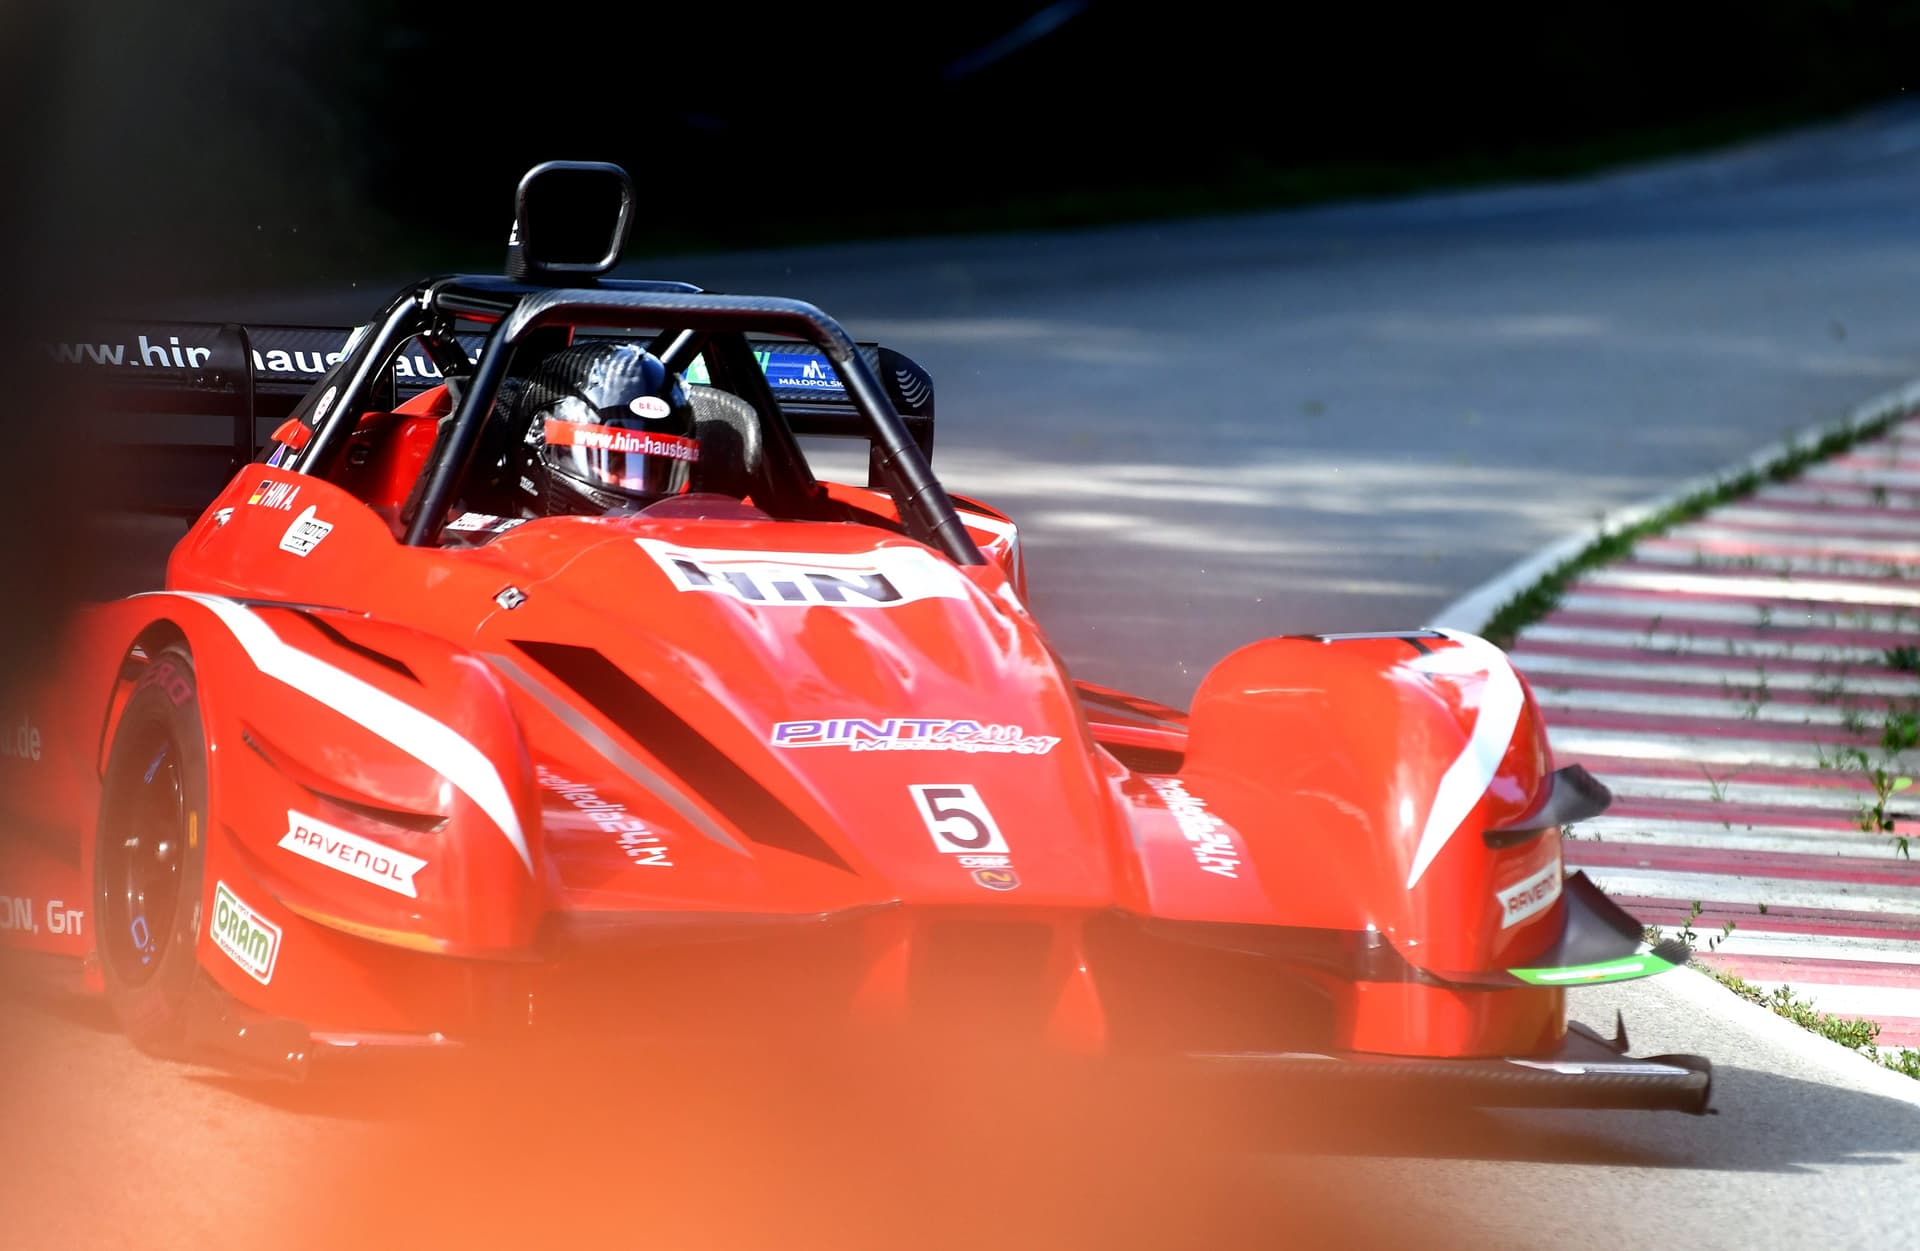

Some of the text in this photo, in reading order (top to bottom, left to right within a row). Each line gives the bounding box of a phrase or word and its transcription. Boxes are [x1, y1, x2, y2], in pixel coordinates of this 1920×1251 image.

[778, 378, 845, 388] MAŁOPOLSK
[638, 400, 665, 413] BELL
[771, 719, 982, 746] PINTA
[921, 788, 992, 850] 5
[293, 826, 403, 881] RAVENOL
[217, 899, 269, 965] ORAM
